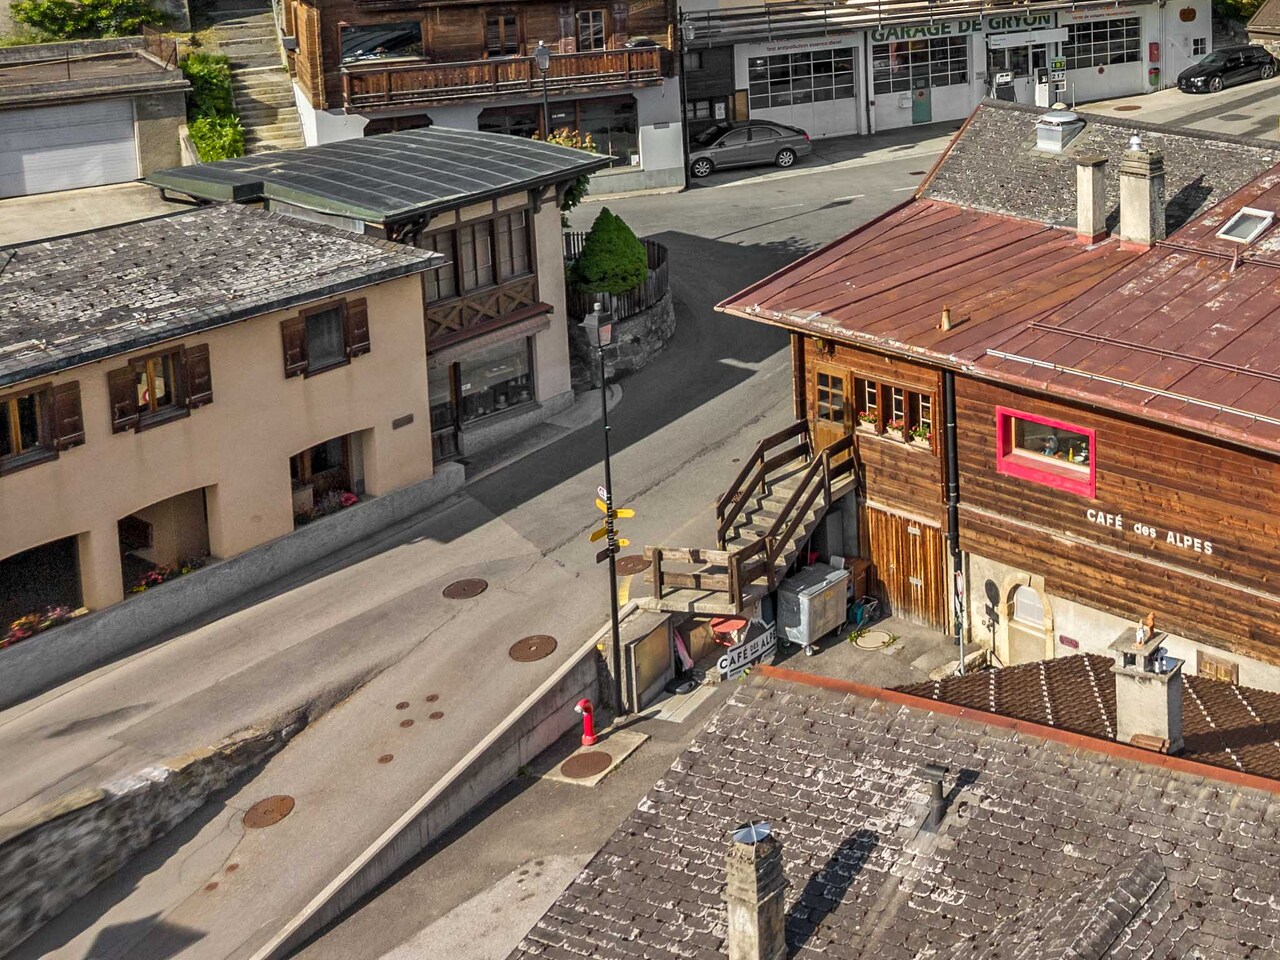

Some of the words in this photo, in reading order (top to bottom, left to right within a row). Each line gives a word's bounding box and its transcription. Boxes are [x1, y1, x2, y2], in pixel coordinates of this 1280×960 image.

[871, 22, 951, 43] GARAGE
[958, 19, 982, 34] DE
[988, 13, 1051, 31] GRYON
[1086, 508, 1123, 530] CAFÉ
[1133, 522, 1157, 539] des
[1166, 530, 1213, 555] ALPES
[719, 645, 748, 669] CAFÉ
[761, 629, 777, 649] ALPE
